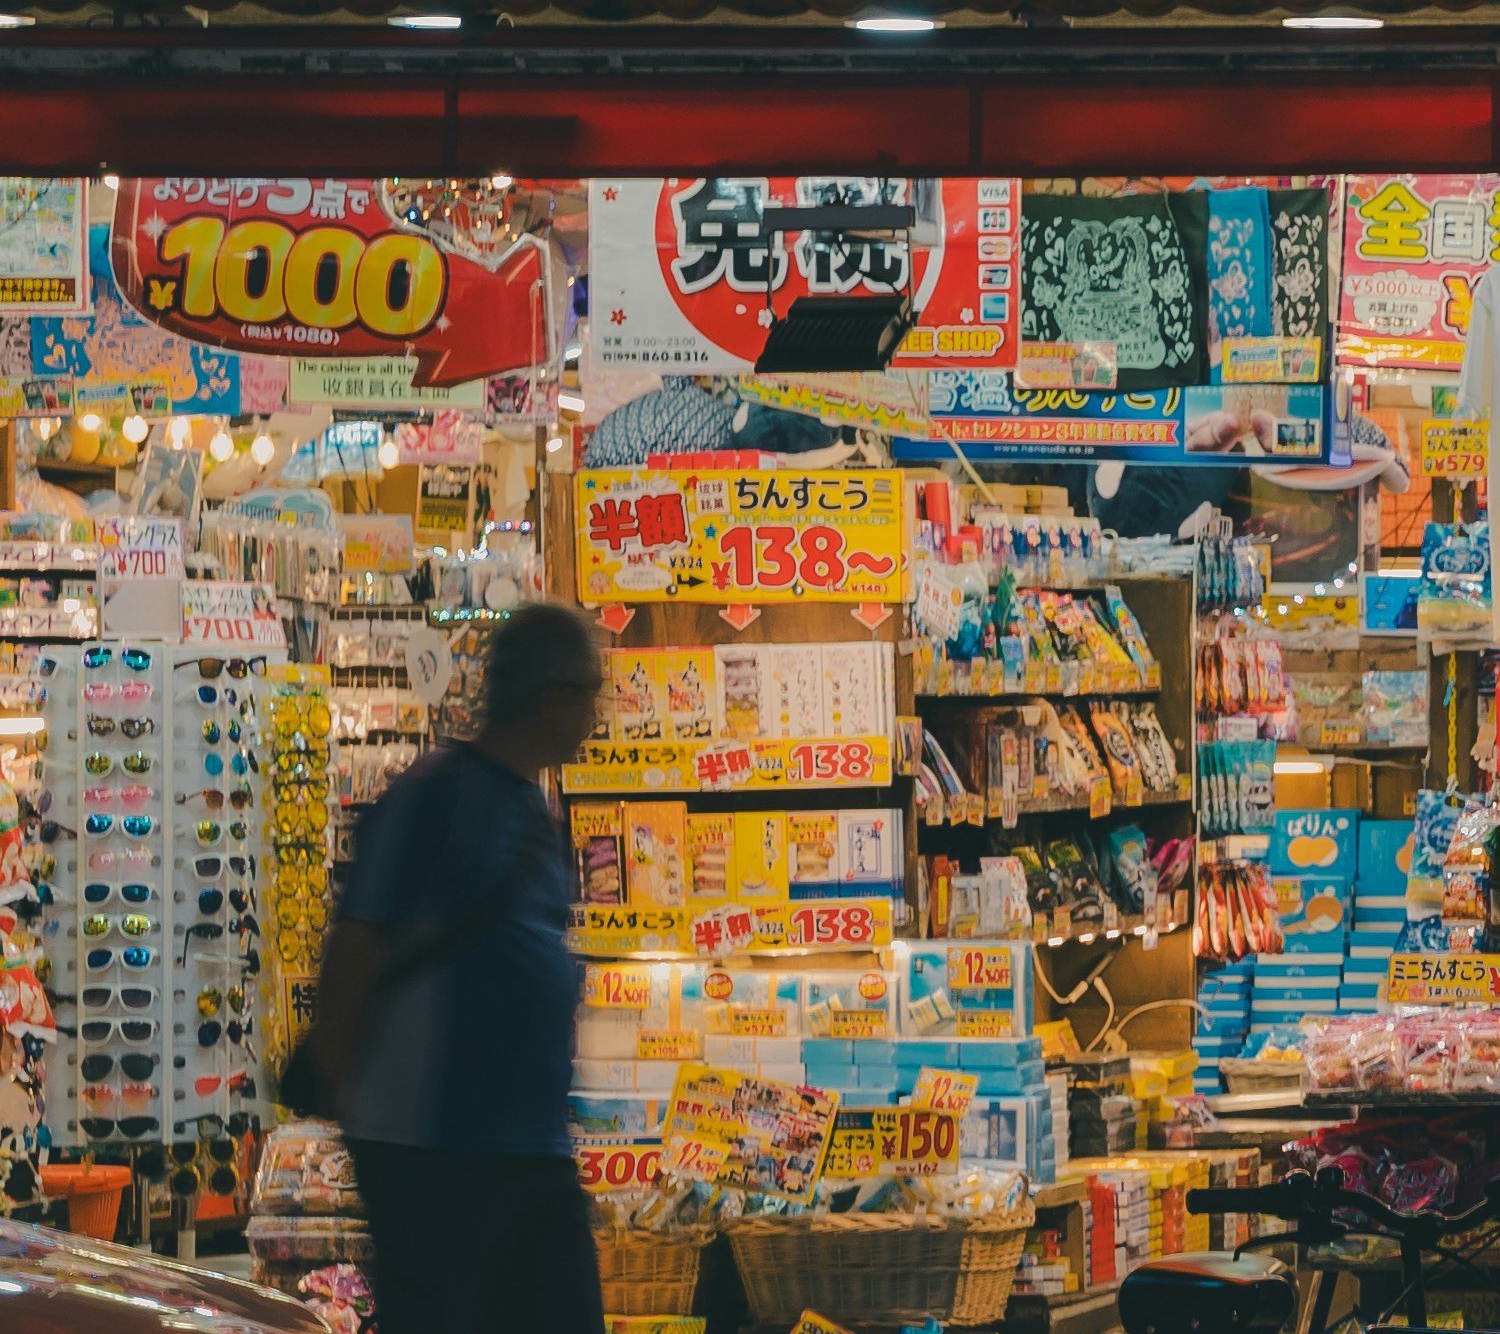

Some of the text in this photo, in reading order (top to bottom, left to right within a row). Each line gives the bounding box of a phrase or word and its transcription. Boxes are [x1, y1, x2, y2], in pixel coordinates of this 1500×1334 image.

[148, 216, 446, 336] ¥1000
[937, 328, 1004, 356] SHOP
[298, 359, 393, 374] The cashier is all
[1434, 455, 1486, 472] ¥579
[734, 476, 869, 511] ちんすこう
[589, 493, 688, 552] 半額
[589, 746, 678, 766] ちんすこう
[589, 910, 676, 929] ちんすこう
[1393, 959, 1486, 983] ミニちんすこう
[882, 1111, 955, 1159] ¥150
